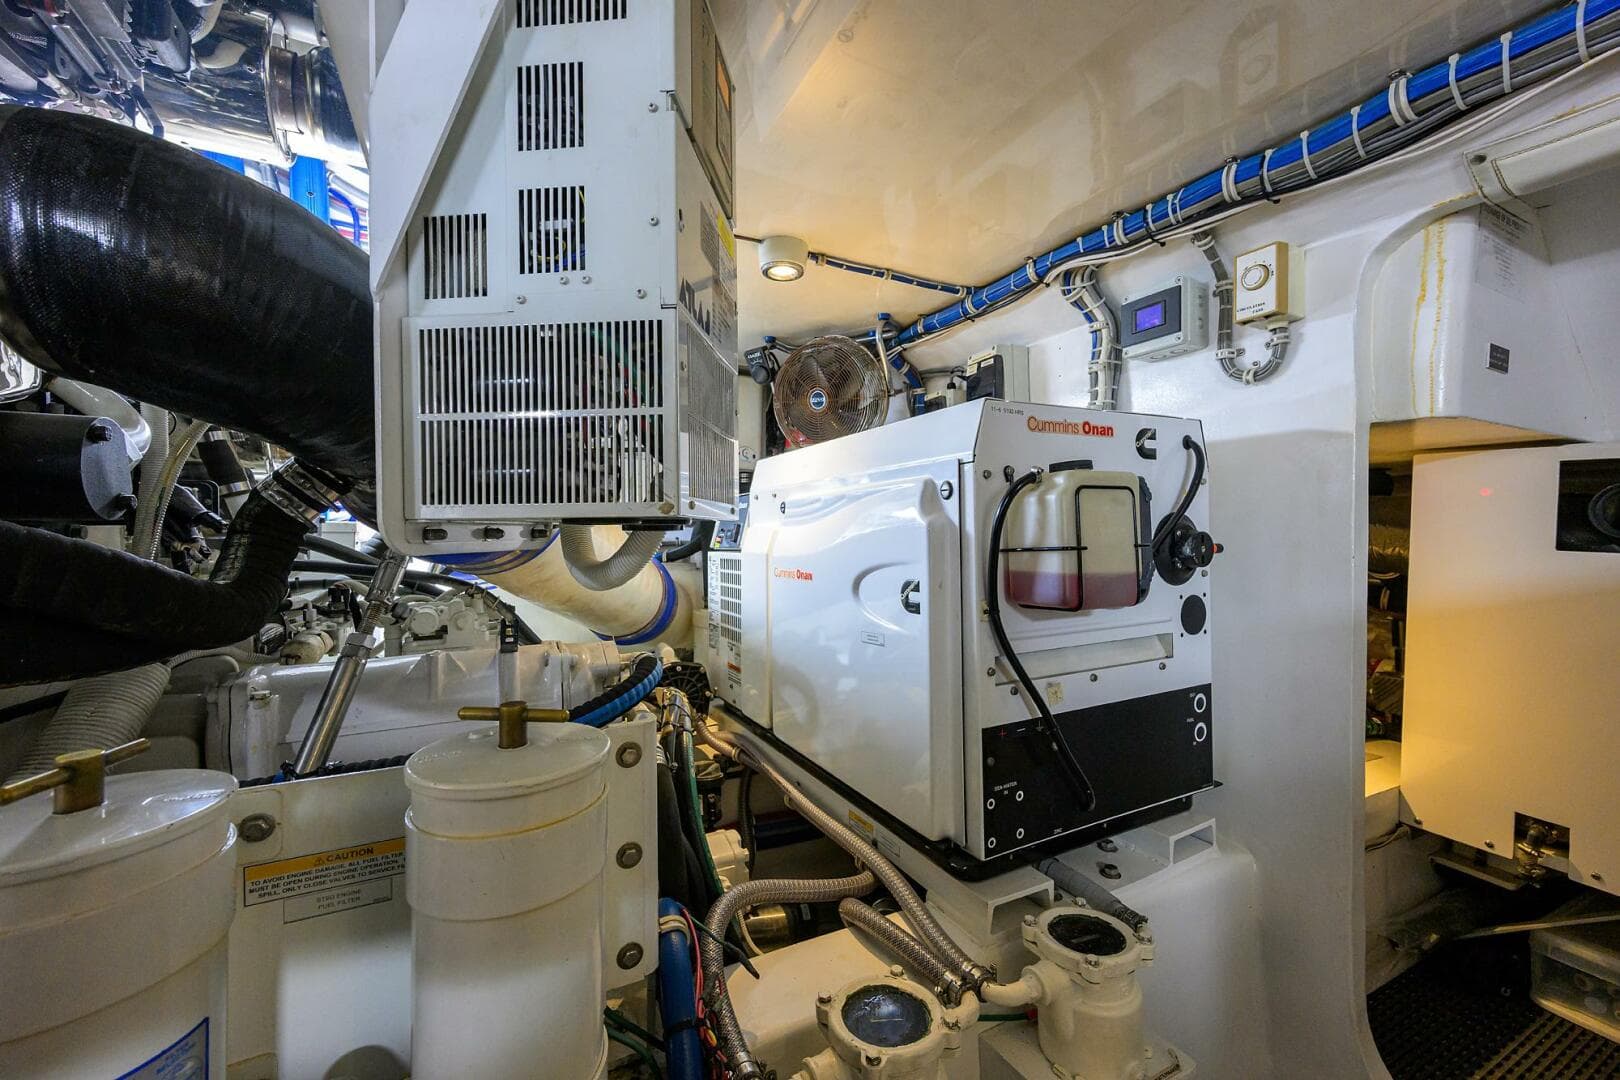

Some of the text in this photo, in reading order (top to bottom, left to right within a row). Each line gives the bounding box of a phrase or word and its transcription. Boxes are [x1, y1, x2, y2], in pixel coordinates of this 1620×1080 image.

[1027, 415, 1114, 437] Cummins Onan
[774, 568, 813, 581] Cummins Onan
[326, 847, 375, 863] CAUTION
[249, 885, 269, 894] MUST
[283, 879, 303, 887] OPEN
[305, 872, 331, 882] DURING
[333, 867, 358, 876] ENGINE
[263, 876, 285, 884] AVOID
[287, 870, 313, 879] ENGINE
[282, 885, 302, 893] ONLY
[304, 880, 328, 888] CLOSE
[329, 874, 356, 883] VALVES
[368, 865, 395, 875] SERVICE
[336, 889, 361, 898] ENGINE
